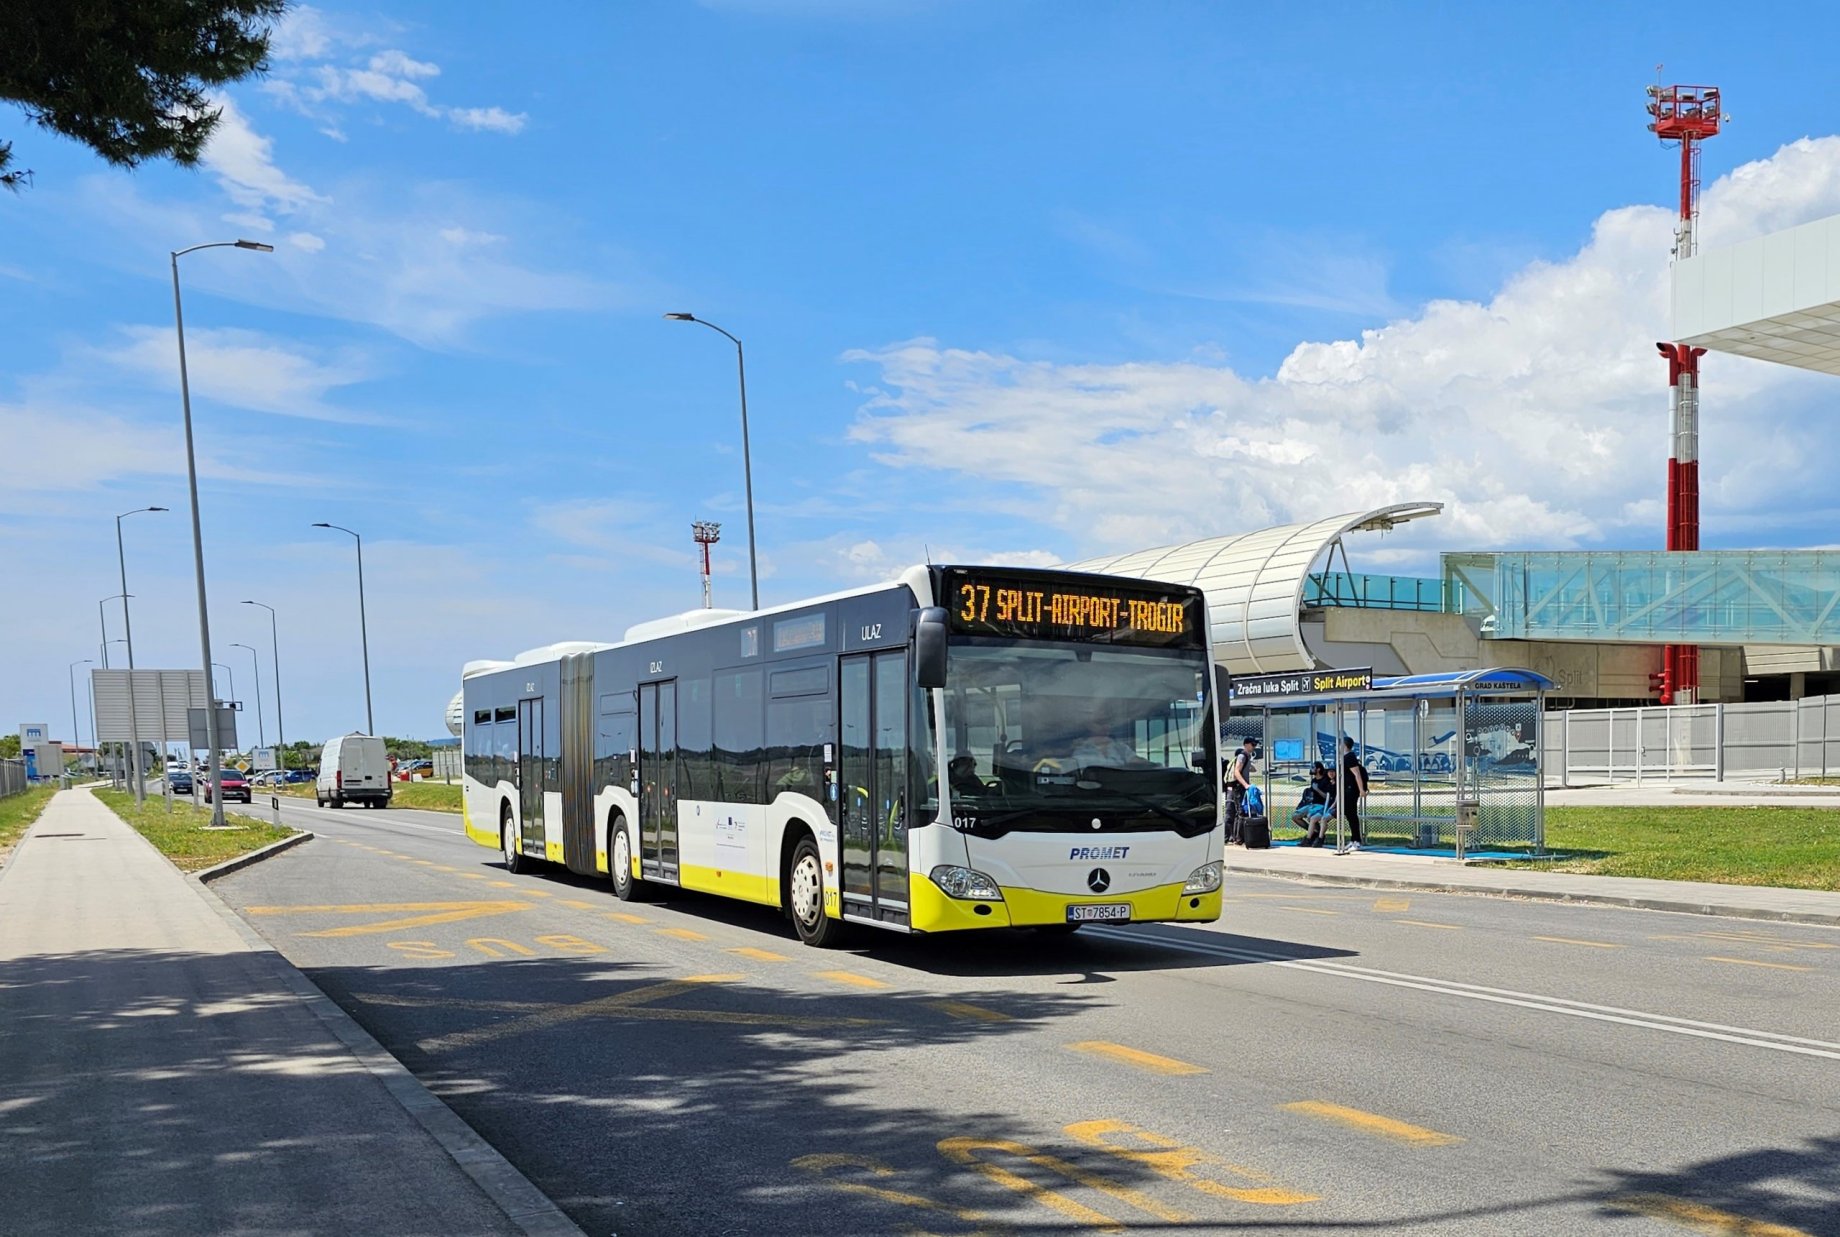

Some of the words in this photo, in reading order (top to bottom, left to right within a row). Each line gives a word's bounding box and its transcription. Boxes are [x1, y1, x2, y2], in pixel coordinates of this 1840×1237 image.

[961, 584, 990, 622] 37
[996, 589, 1184, 633] SPLIT-AIRPORT-TROGIR
[861, 623, 882, 641] ULAZ
[650, 660, 662, 673] IZLAZ
[1237, 683, 1261, 695] Zračna
[1263, 682, 1279, 692] luka
[1280, 680, 1299, 694] Split
[1314, 677, 1334, 692] Split
[1335, 675, 1366, 690] Airport
[1493, 680, 1521, 689] KAŠTELA
[1559, 669, 1582, 687] Split
[954, 816, 977, 829] 017
[1070, 847, 1130, 860] PROMET
[825, 890, 838, 907] 017
[1075, 907, 1087, 919] ST
[386, 934, 610, 959] BUS
